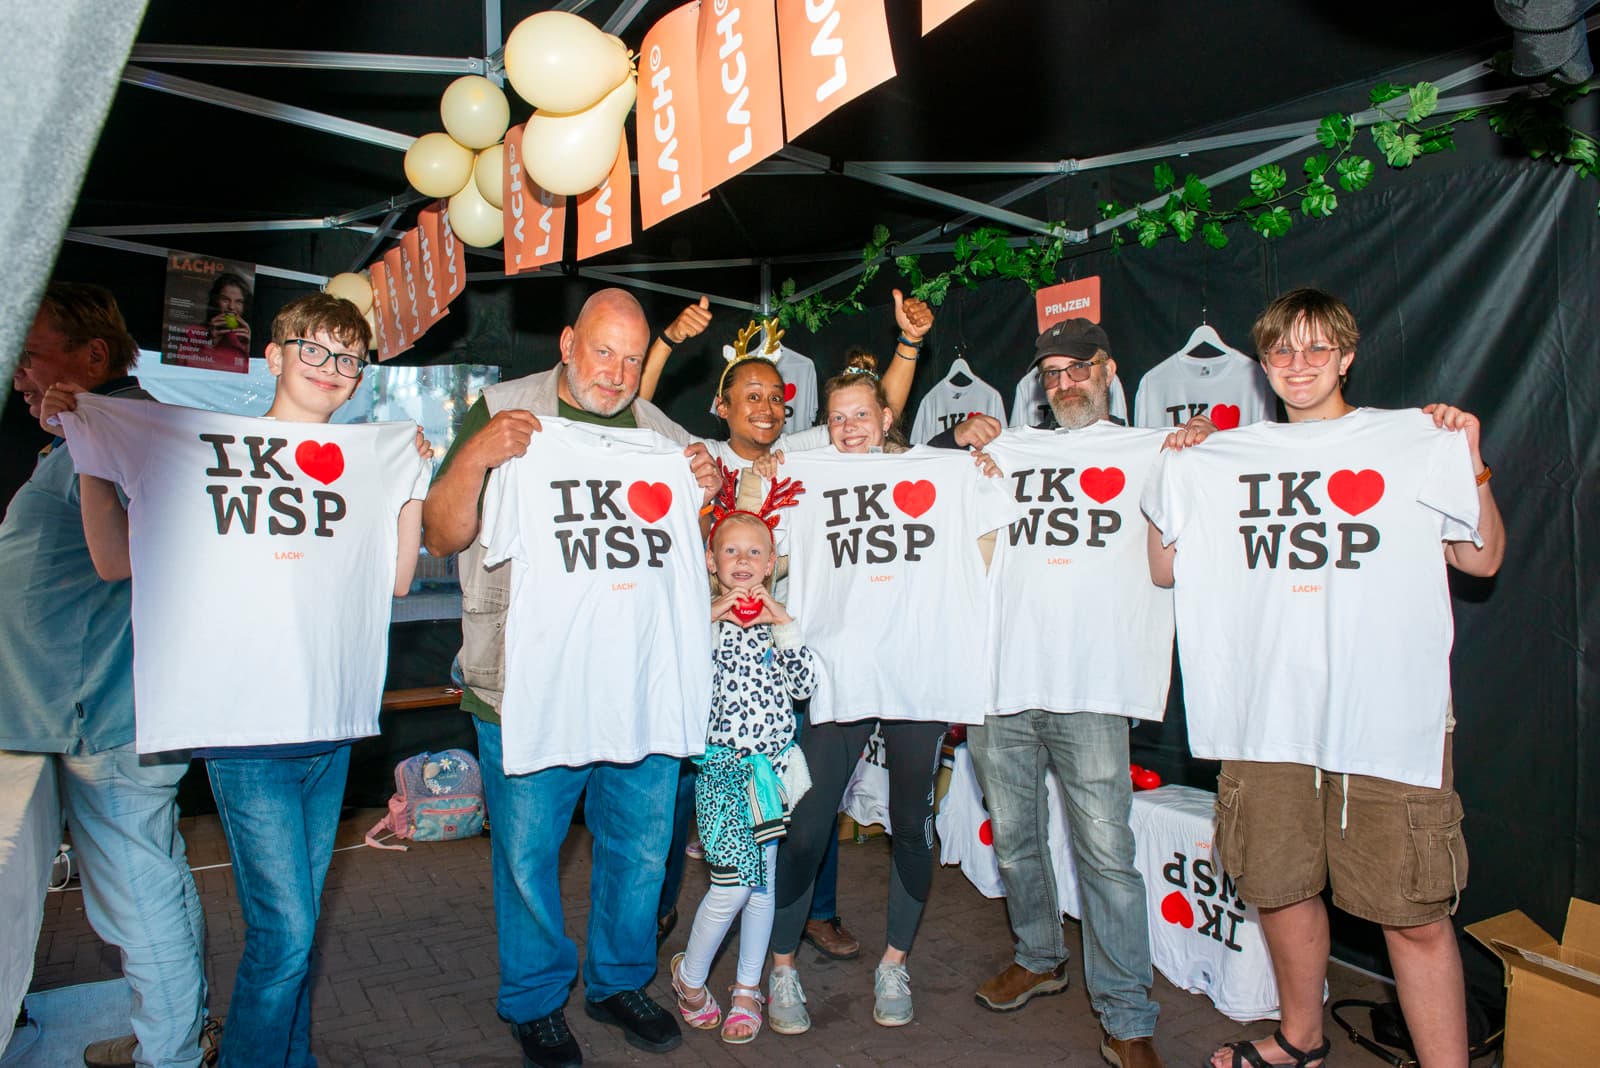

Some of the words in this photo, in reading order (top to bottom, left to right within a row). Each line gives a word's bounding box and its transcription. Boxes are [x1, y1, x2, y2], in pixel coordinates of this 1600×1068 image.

[1045, 296, 1091, 317] PRIJZEN
[199, 433, 294, 481] IK
[550, 479, 627, 523] IK
[823, 483, 890, 527] IK
[1011, 468, 1075, 503] IK
[1238, 471, 1322, 518] IK
[206, 485, 347, 538] WSP
[1008, 507, 1122, 548] WSP
[555, 526, 672, 573] WSP
[826, 523, 936, 569] WSP
[1238, 522, 1381, 570] WSP
